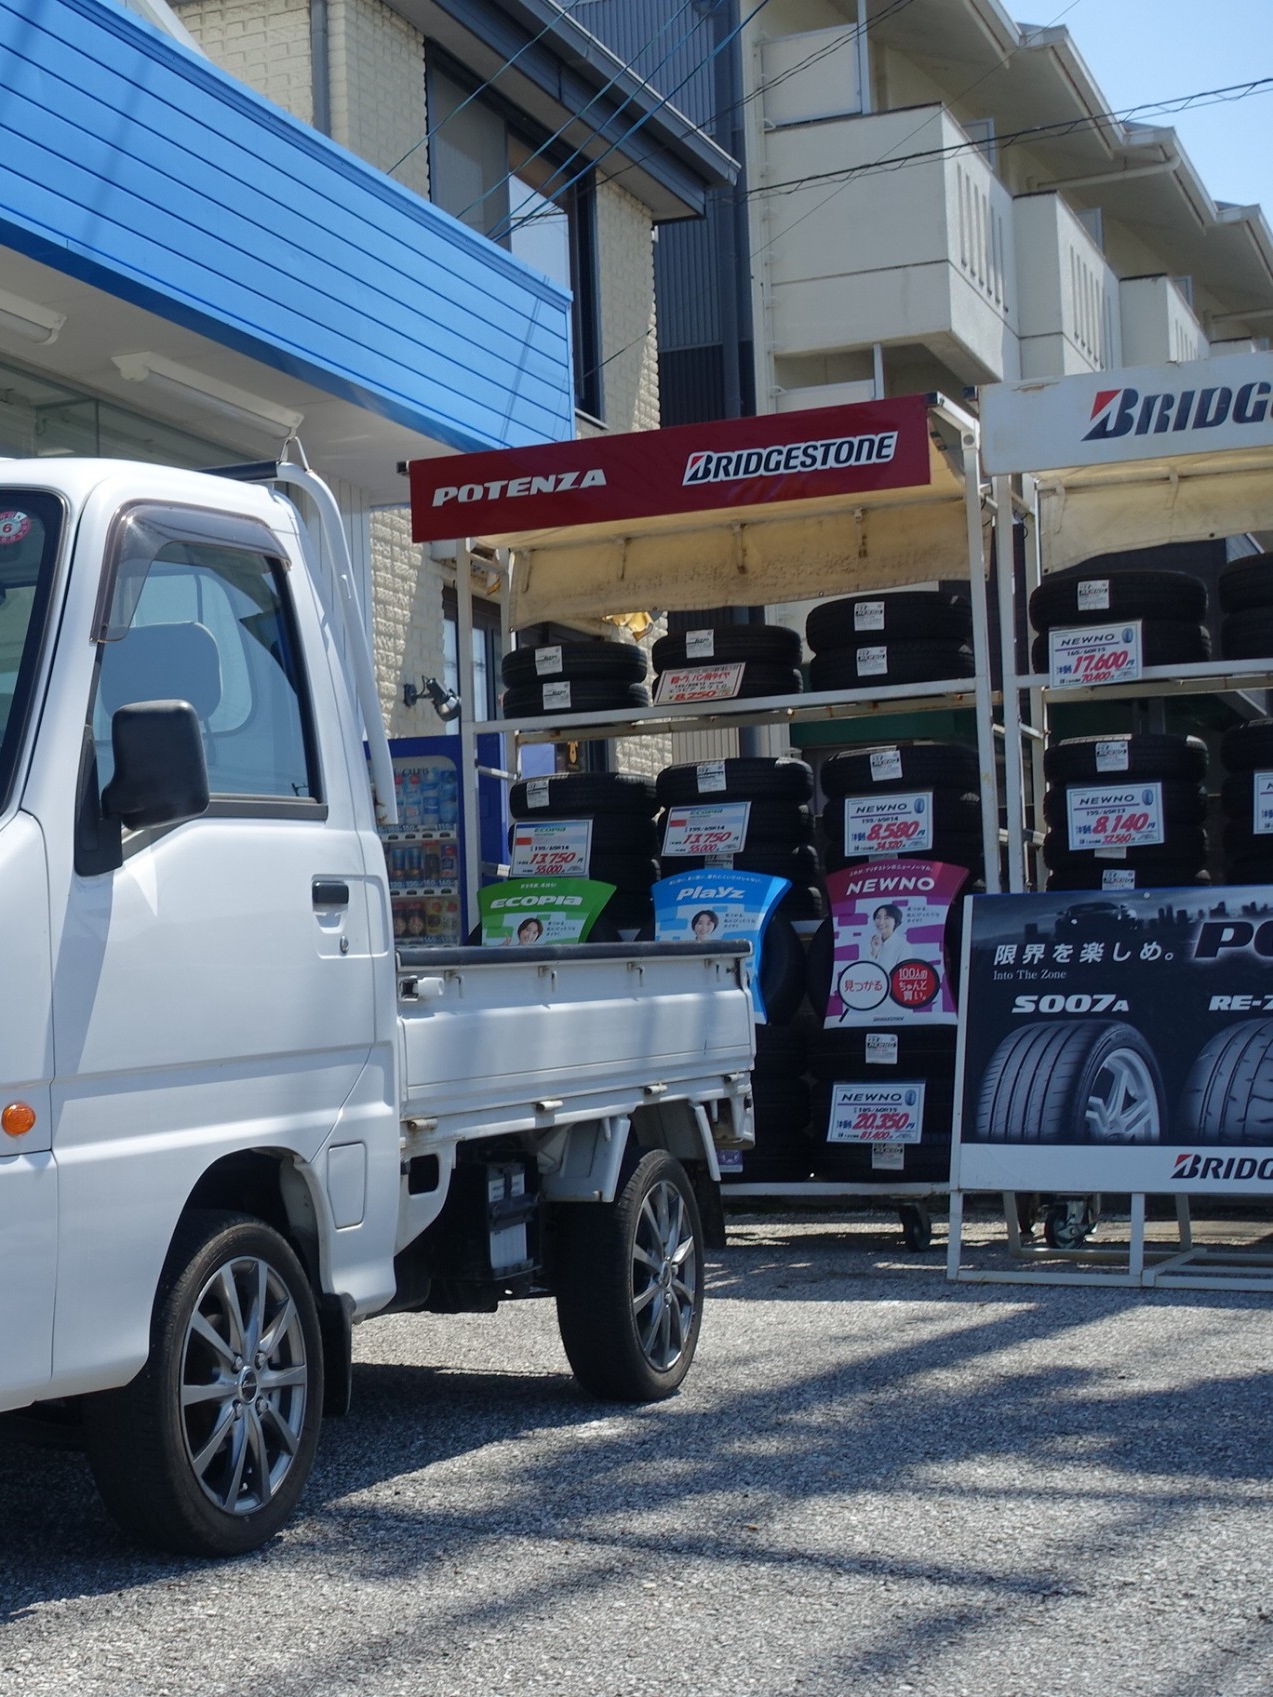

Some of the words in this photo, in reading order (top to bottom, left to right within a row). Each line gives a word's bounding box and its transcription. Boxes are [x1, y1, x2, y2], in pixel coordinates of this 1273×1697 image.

[1080, 381, 1273, 441] BRIDG
[684, 432, 898, 485] BRIDGESTONE
[431, 468, 607, 507] POTENZA
[2, 523, 13, 533] 6
[1061, 634, 1115, 646] NEWNO
[1079, 794, 1135, 806] NEWNO
[856, 803, 907, 814] NEWNO
[846, 877, 935, 896] NEWNO
[993, 941, 1174, 966] 限界を楽しめ。
[993, 970, 1013, 980] Into
[1016, 970, 1038, 980] The
[1041, 969, 1067, 979] Zone
[844, 979, 883, 992] 見つかる
[1011, 994, 1130, 1013] S007A
[841, 1093, 902, 1102] NEWNO
